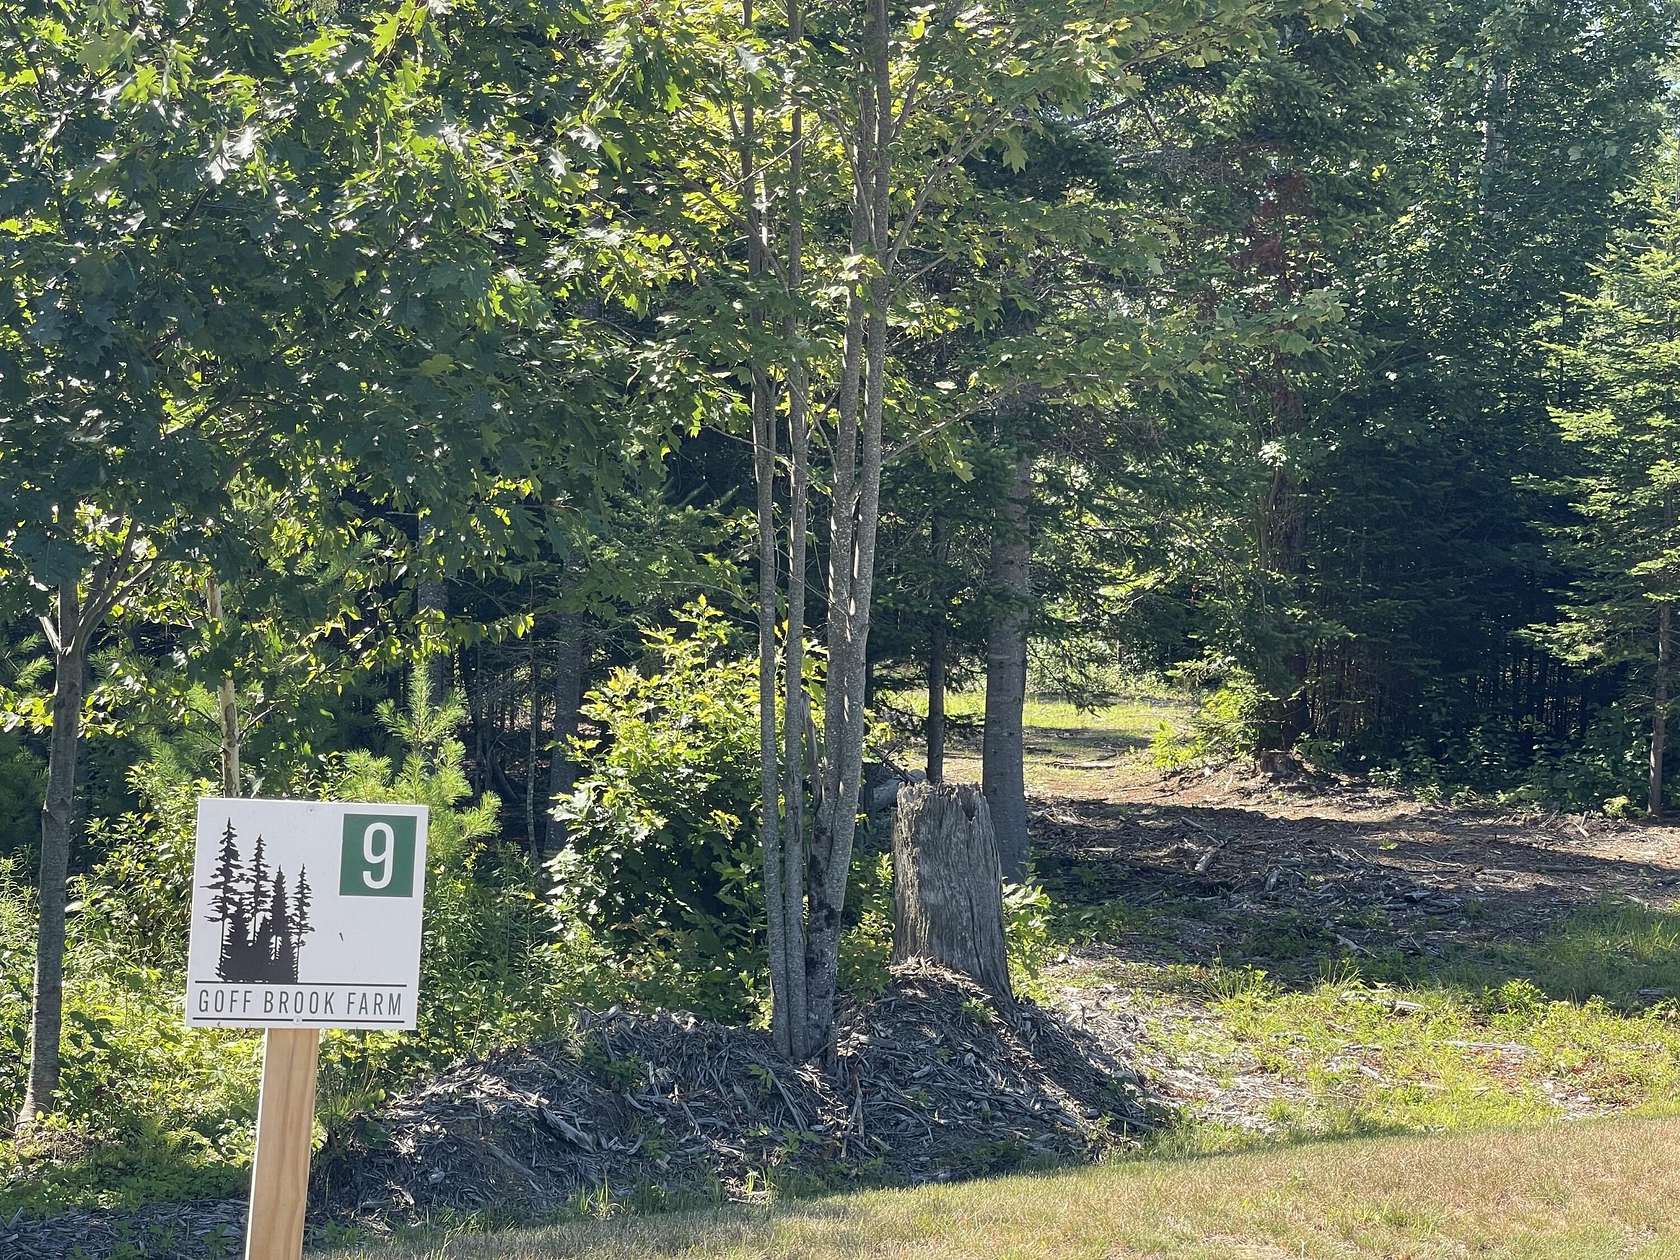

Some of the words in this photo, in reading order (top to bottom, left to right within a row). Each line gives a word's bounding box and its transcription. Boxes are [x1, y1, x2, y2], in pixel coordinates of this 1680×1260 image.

[362, 822, 395, 889] 9
[198, 989, 253, 1013] GOFF
[263, 990, 335, 1014] BROOK
[346, 992, 402, 1016] FARM
